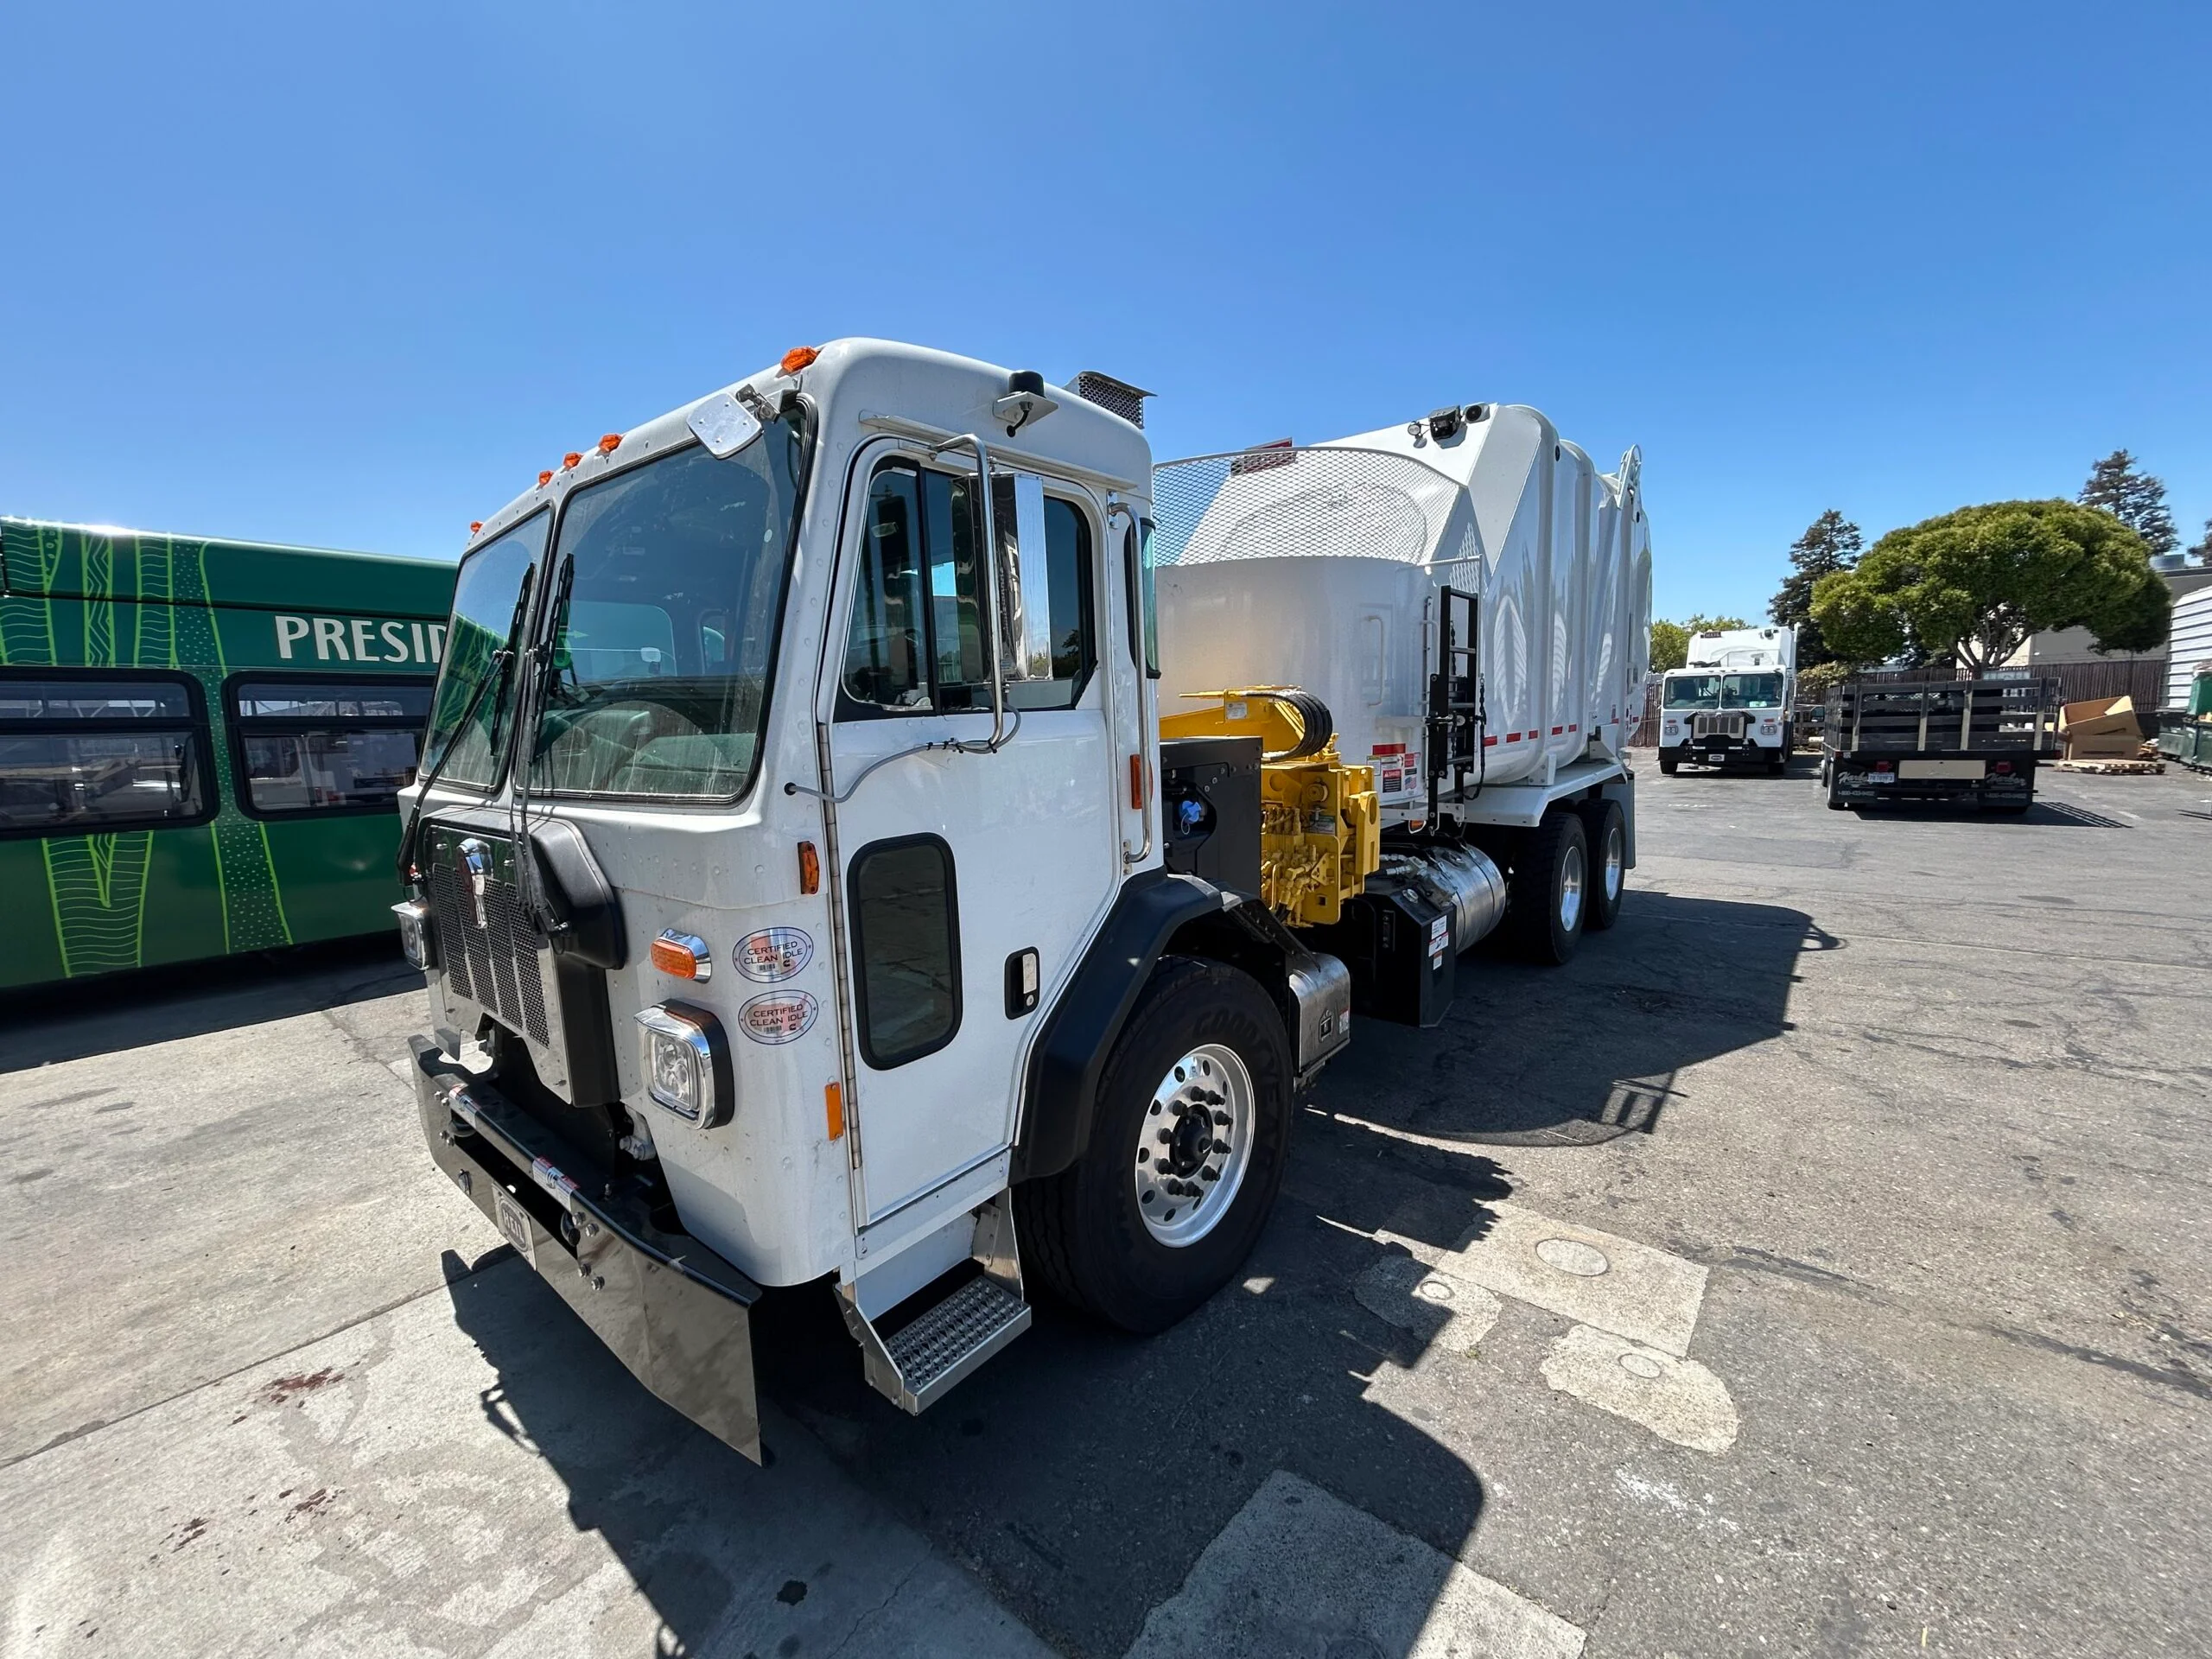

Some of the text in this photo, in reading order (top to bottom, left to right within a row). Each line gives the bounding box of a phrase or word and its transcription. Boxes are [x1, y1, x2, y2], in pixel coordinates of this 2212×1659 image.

[747, 941, 798, 956] CERTIFIED
[744, 948, 804, 965] CLEAN IDLE
[753, 1004, 804, 1018] CERTIFIED
[749, 1011, 808, 1027] CLEAN IDLE
